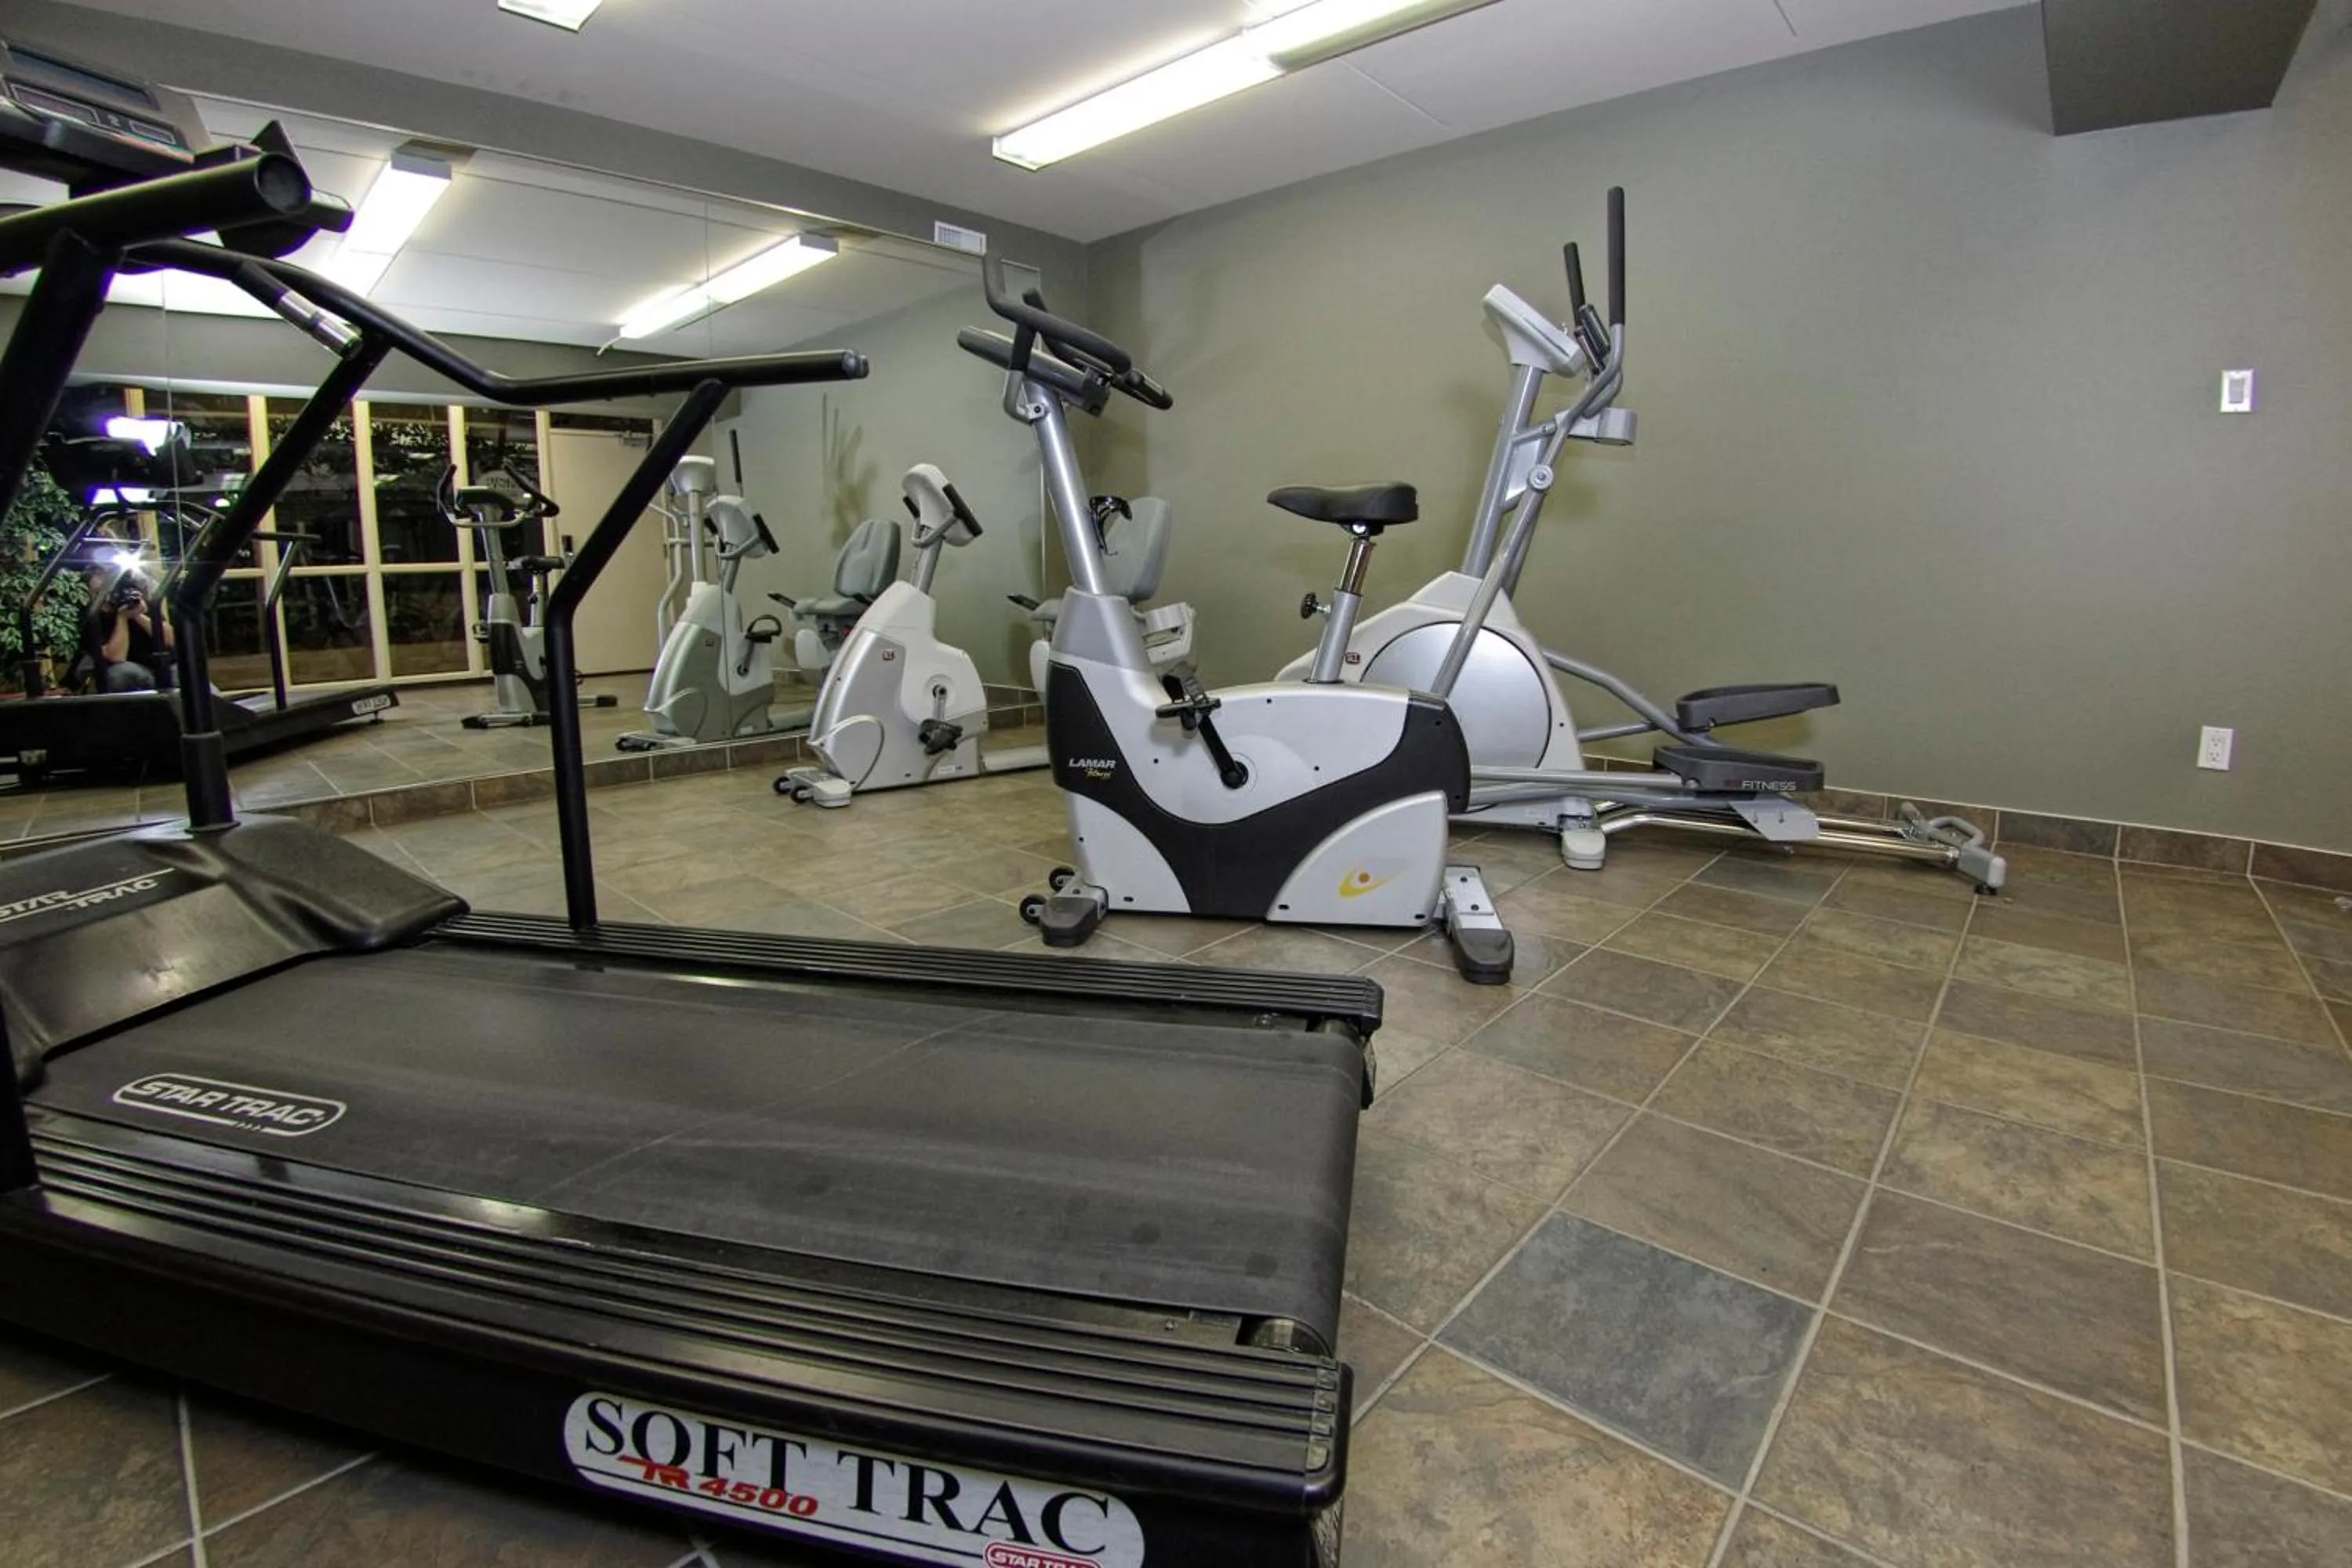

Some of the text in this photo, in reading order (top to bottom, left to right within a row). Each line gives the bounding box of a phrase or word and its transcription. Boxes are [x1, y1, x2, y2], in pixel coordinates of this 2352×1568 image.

[1069, 757, 1116, 769] LAMAR
[1741, 780, 1796, 791] FITNESS
[74, 879, 158, 908] TRAC
[128, 1080, 327, 1125] STAR TRAC
[584, 1396, 1109, 1555] SOFT TRAC
[699, 1478, 819, 1517] 4500
[991, 1551, 1041, 1568] STAR
